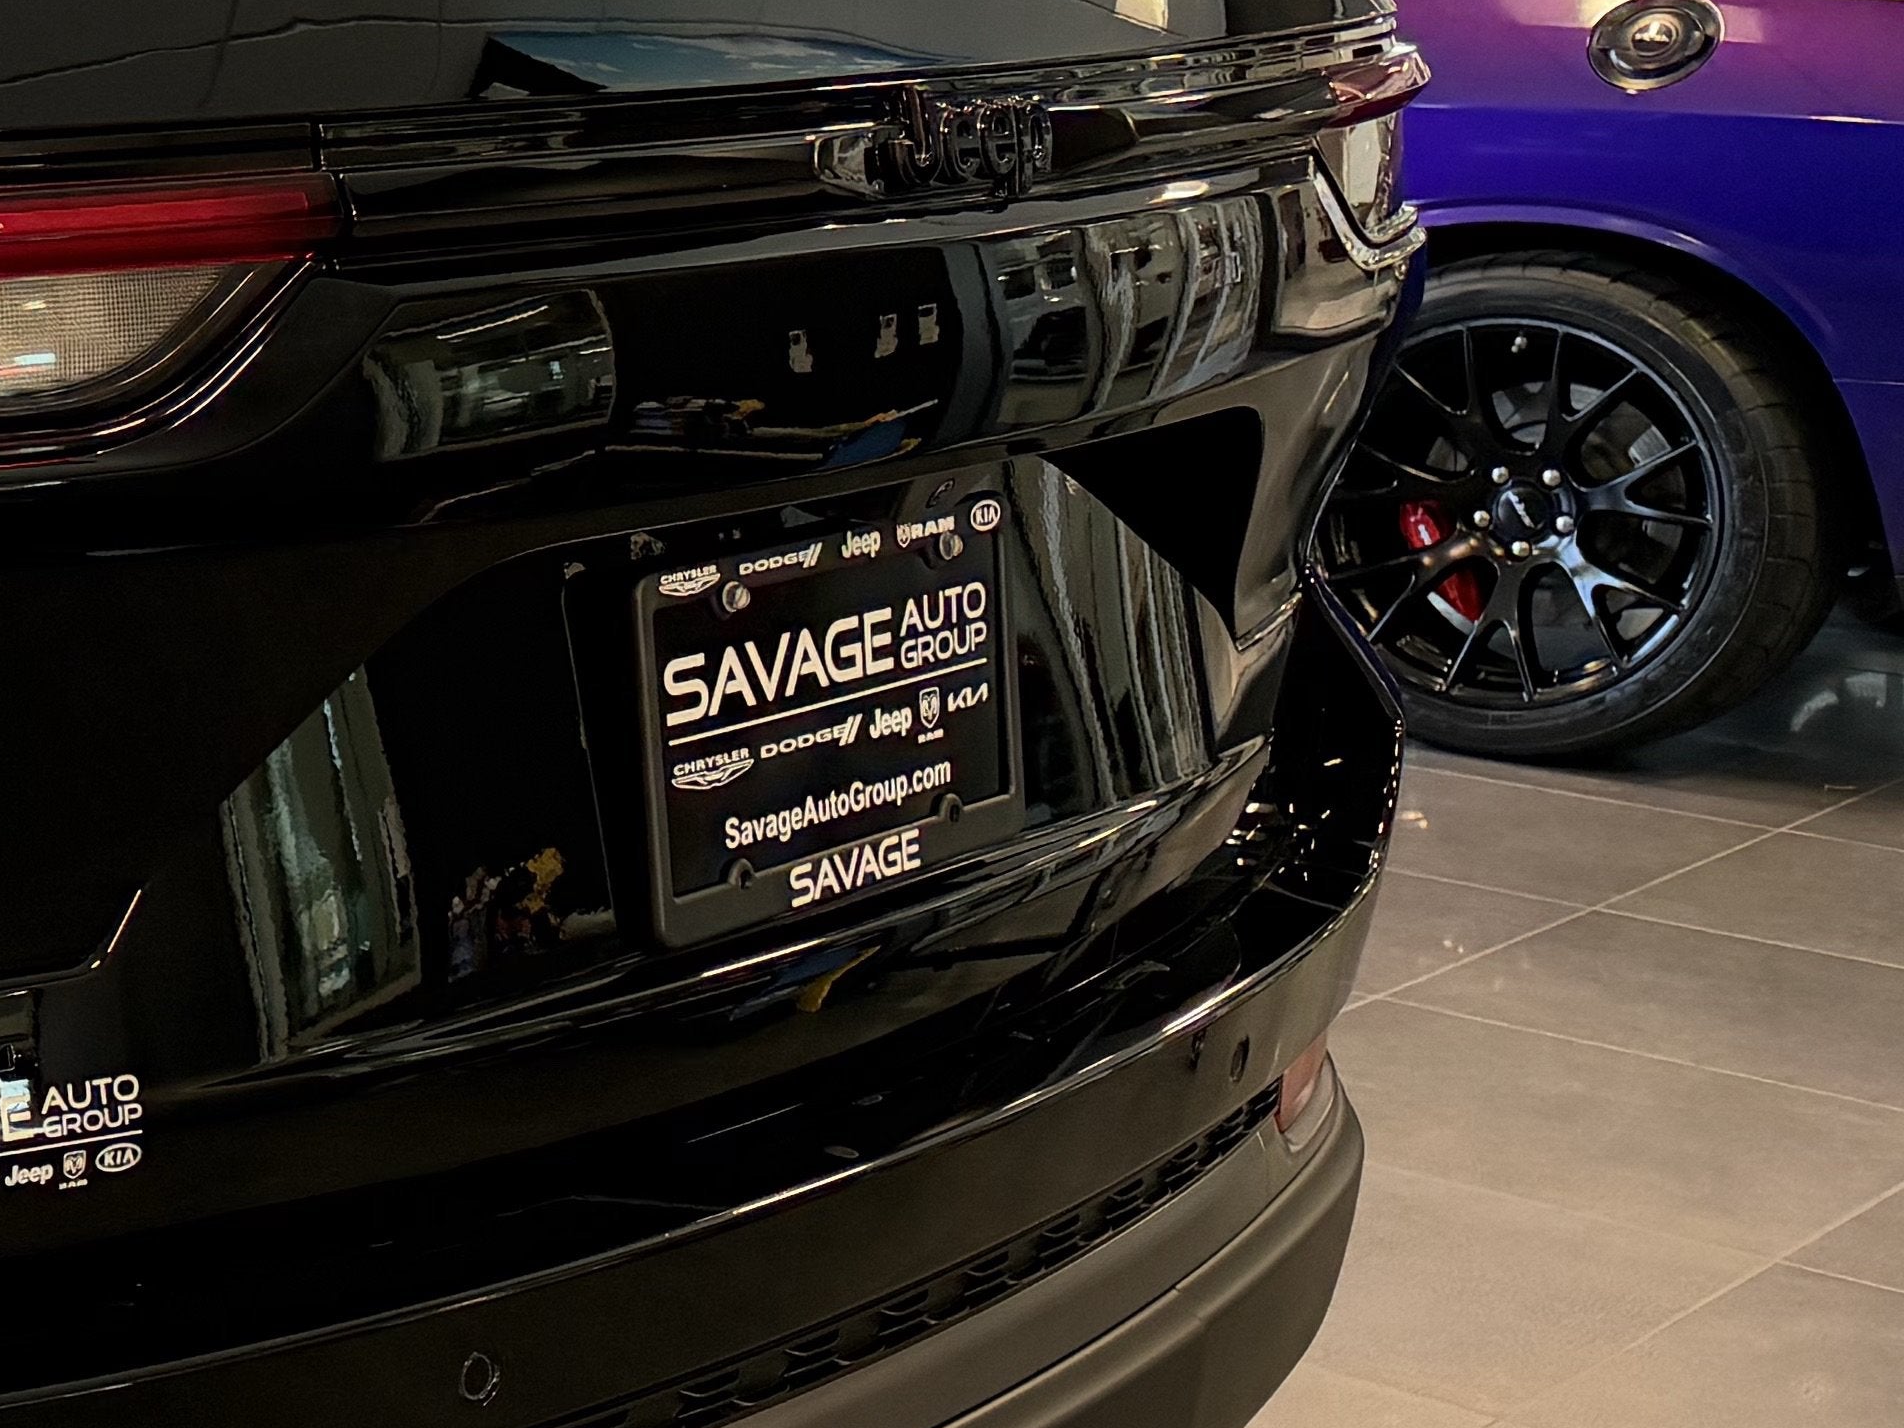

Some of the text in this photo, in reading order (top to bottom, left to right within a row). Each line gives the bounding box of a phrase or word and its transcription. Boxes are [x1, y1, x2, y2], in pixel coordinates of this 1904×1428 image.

[878, 85, 1053, 199] Jeep
[659, 503, 998, 585] CHRYSLER DODGE Jeep RAM KIA
[899, 581, 987, 637] AUTO
[899, 620, 988, 670] GROUP
[663, 606, 895, 728] SAVAGE
[672, 747, 751, 777] CHRYSLER
[759, 724, 847, 760] DODGE
[868, 705, 913, 740] Jeep
[724, 760, 952, 850] SavageAutoGroup.com
[789, 827, 923, 908] SAVAGE
[41, 1073, 141, 1115] AUTO
[42, 1102, 144, 1140] GROUP
[4, 1163, 55, 1188] Jeep
[102, 1146, 138, 1169] KIA
